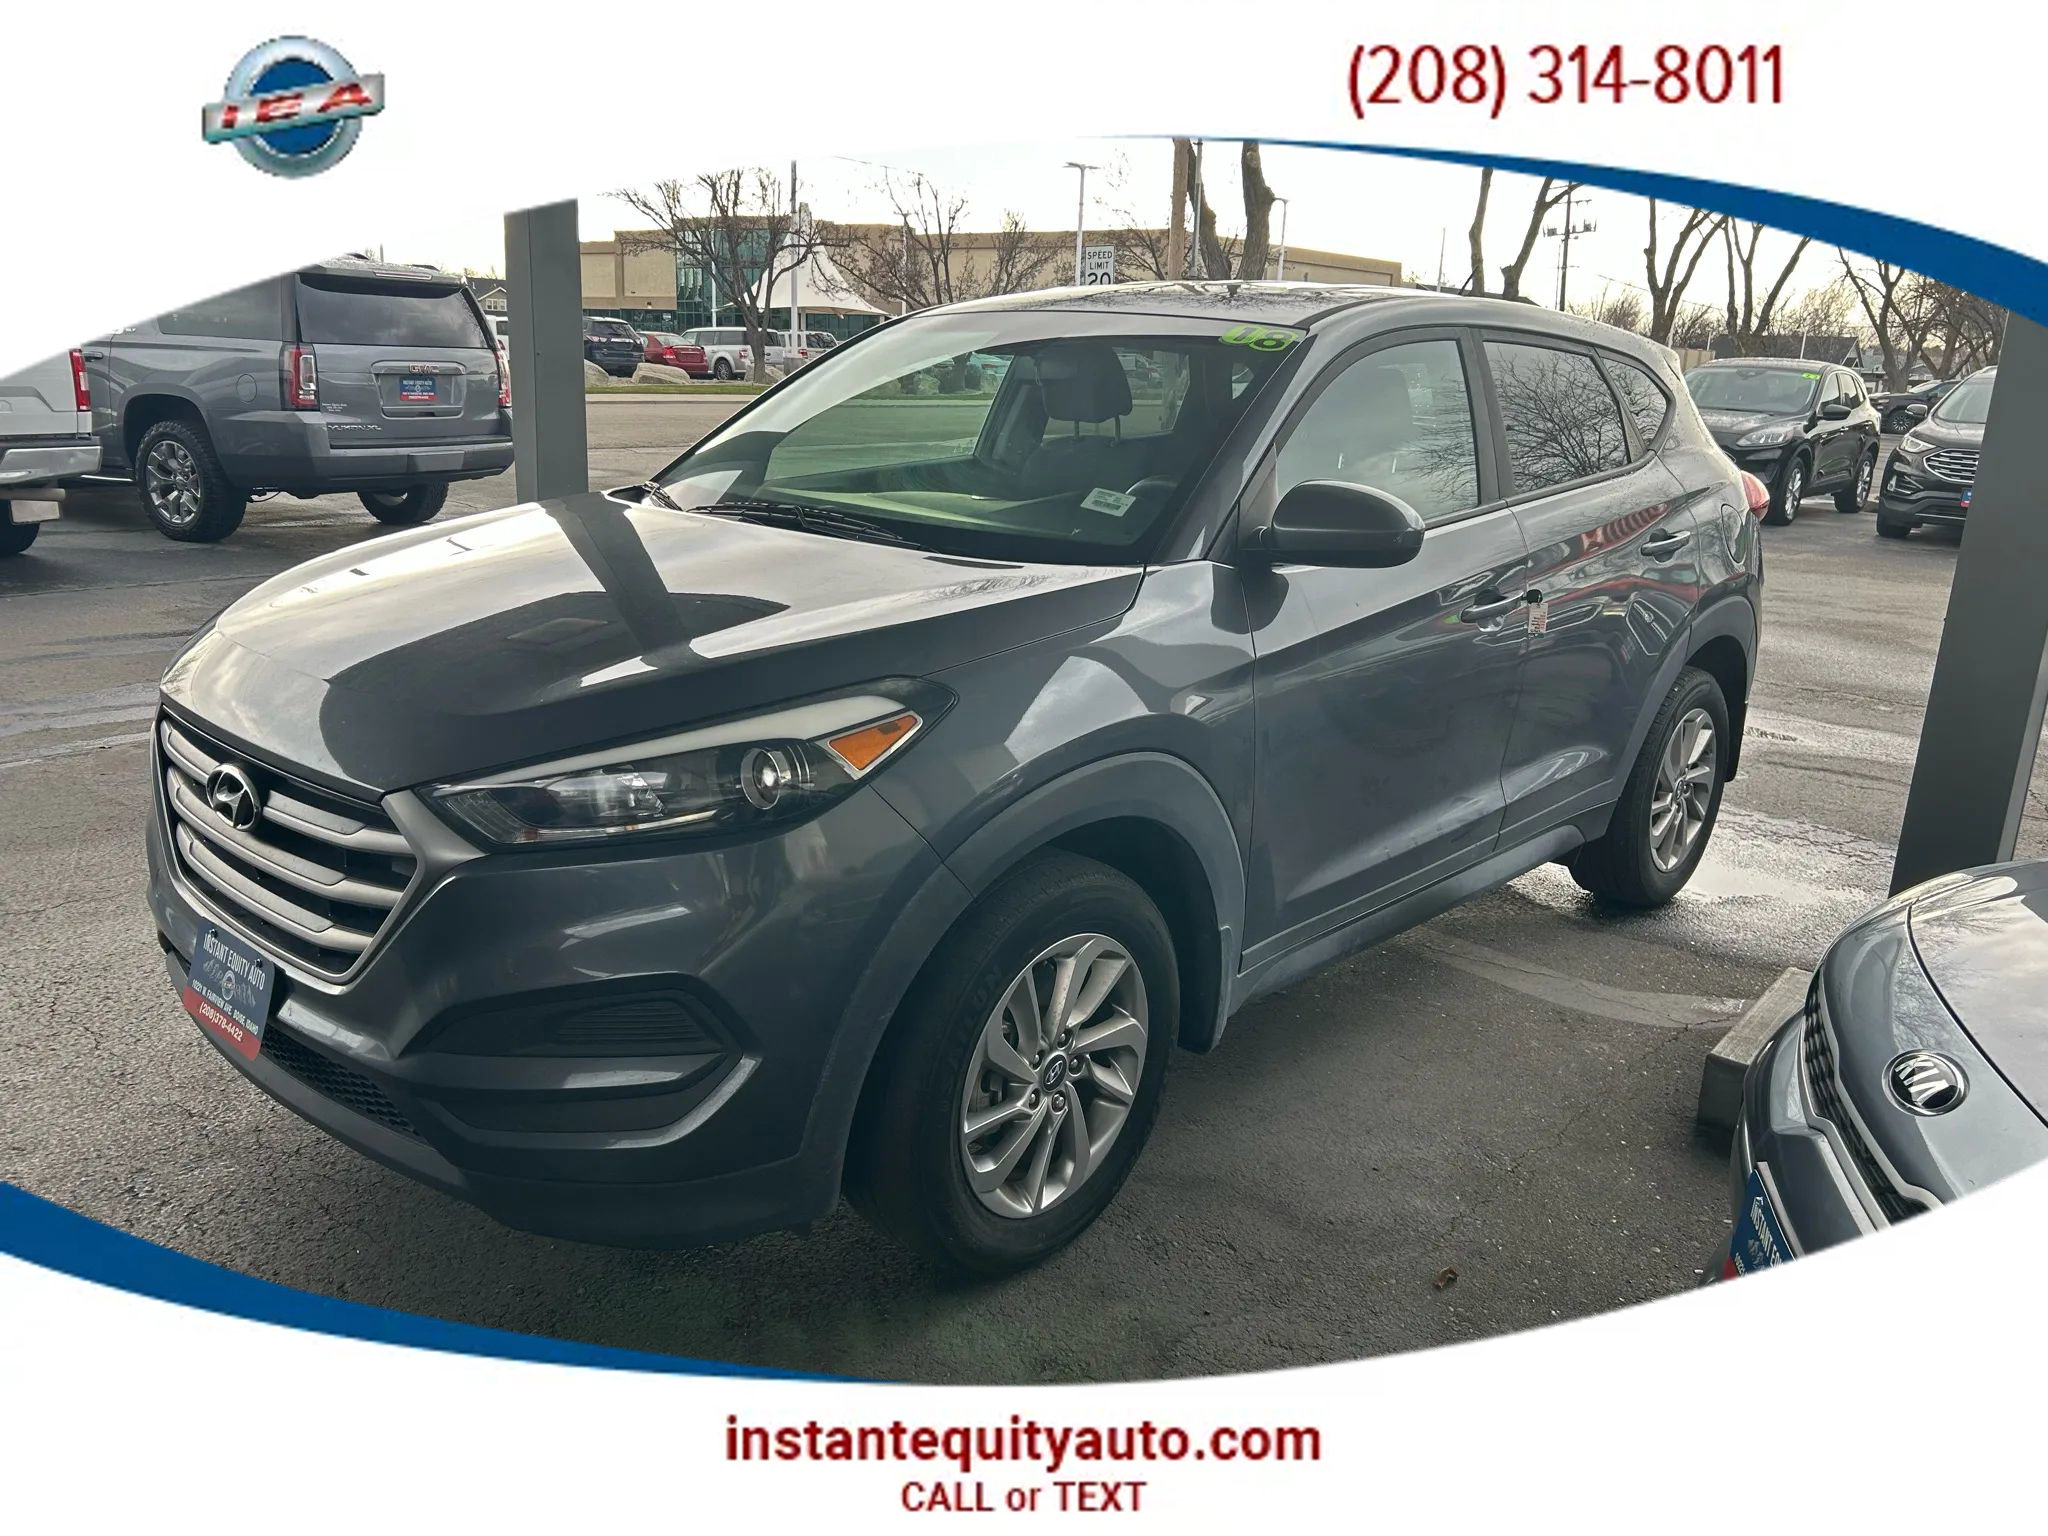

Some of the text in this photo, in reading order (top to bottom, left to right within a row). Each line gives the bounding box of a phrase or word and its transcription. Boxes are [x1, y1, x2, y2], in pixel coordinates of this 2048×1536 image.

[1087, 251, 1113, 260] SPEED
[1089, 261, 1109, 270] LIMIT
[203, 932, 266, 991] INSTANT EQUITY AUTO
[1894, 1054, 1950, 1107] KIA
[1750, 1197, 1773, 1258] INSTANT
